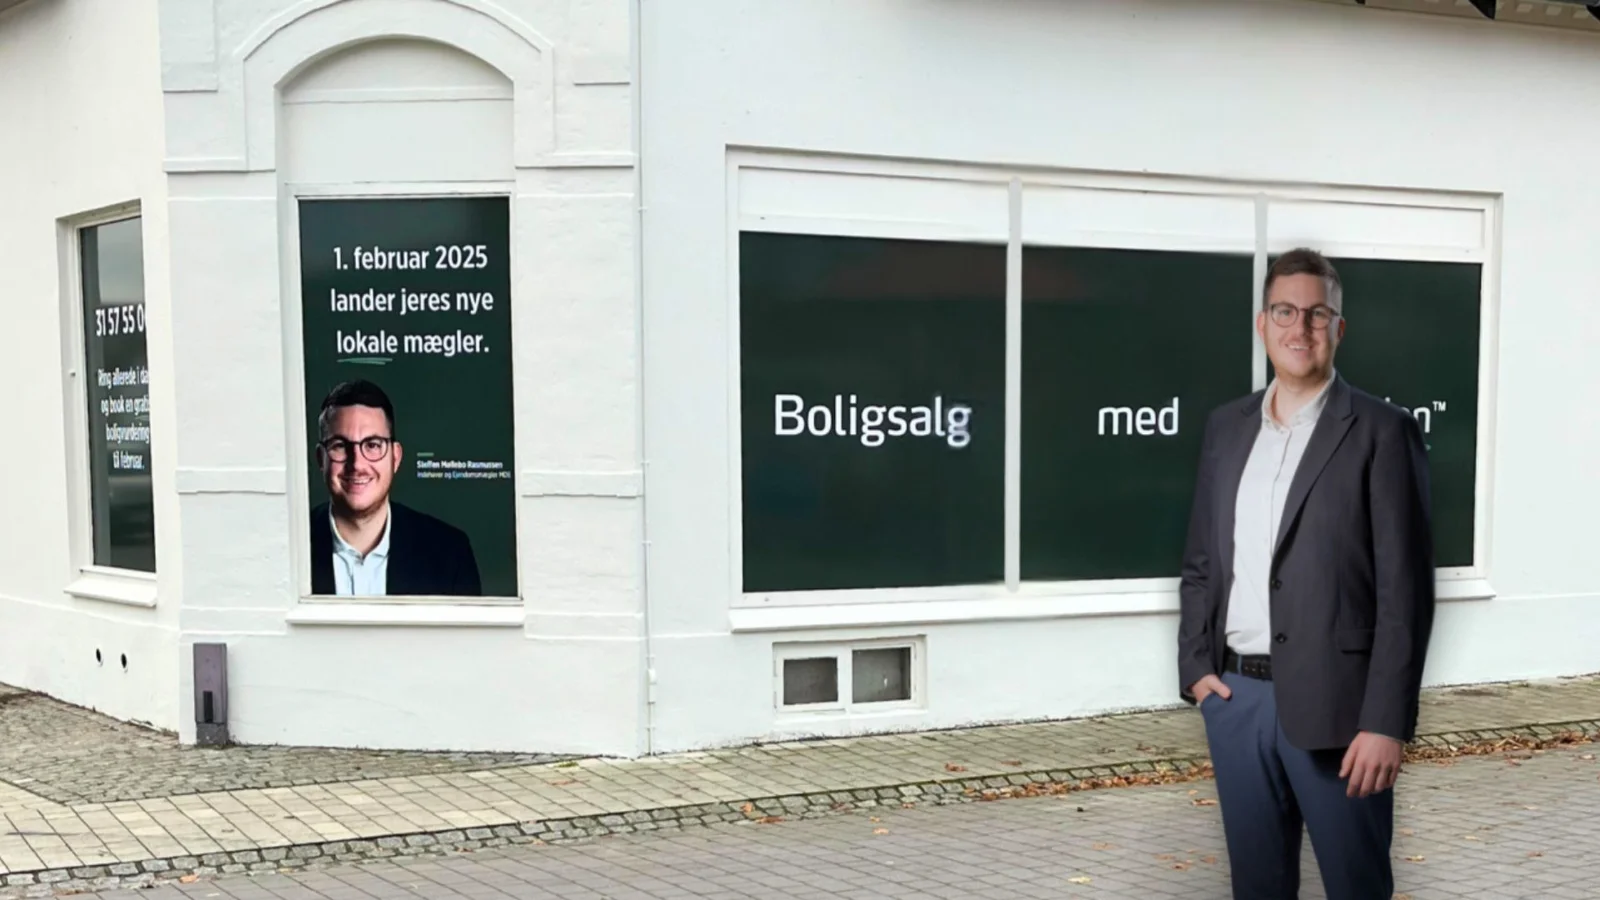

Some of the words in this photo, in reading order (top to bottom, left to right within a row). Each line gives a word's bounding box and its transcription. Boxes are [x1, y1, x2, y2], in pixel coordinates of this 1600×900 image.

[333, 246, 348, 270] 1.
[353, 246, 430, 270] februar
[435, 245, 488, 269] 2025
[330, 287, 396, 312] lander
[400, 287, 451, 315] jeres
[456, 291, 494, 315] nye
[95, 308, 106, 336] 31
[107, 306, 120, 336] 57
[122, 304, 136, 334] 55
[137, 303, 146, 332] 0
[336, 329, 398, 353] lokale
[404, 329, 490, 357] mægler.
[97, 368, 112, 390] Ring
[101, 399, 109, 416] og
[109, 395, 125, 413] book
[125, 398, 134, 413] en
[774, 393, 973, 447] Boligsalg
[1097, 397, 1180, 436] med
